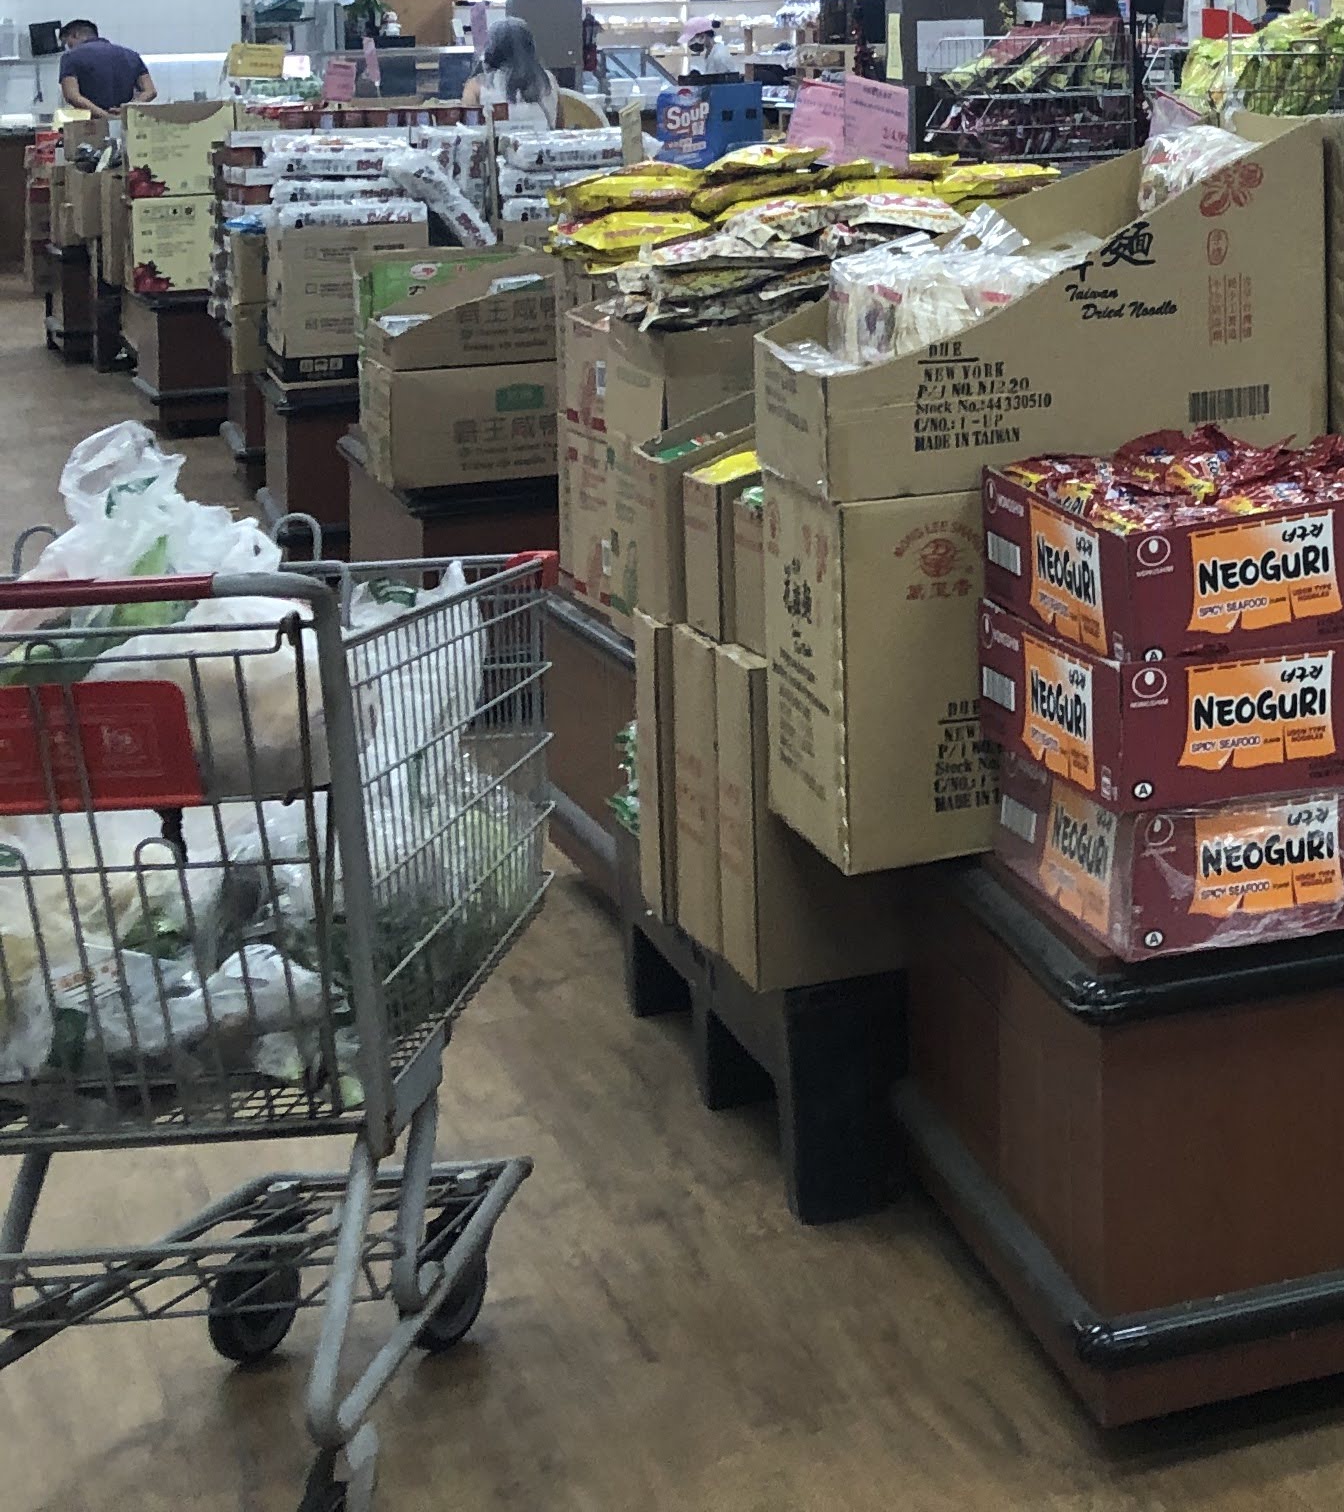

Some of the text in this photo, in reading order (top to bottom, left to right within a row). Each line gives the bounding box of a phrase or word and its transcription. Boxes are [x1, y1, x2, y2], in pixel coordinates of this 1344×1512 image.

[1064, 284, 1119, 301] Taiwan
[1081, 300, 1178, 320] Dried Noodle
[924, 361, 1005, 383] NEW YORK
[916, 400, 953, 416] Stock
[914, 427, 1021, 452] MADE IN TAIWAN
[1036, 535, 1097, 607] NEOGURI
[1198, 544, 1330, 596] NEOGURI
[1030, 669, 1088, 741] NEOGURI
[1193, 686, 1327, 731] NEOGURI
[944, 726, 976, 742] NEW
[934, 759, 972, 776] Stock
[934, 794, 971, 813] MADE
[1200, 831, 1335, 879] NEOGURI
